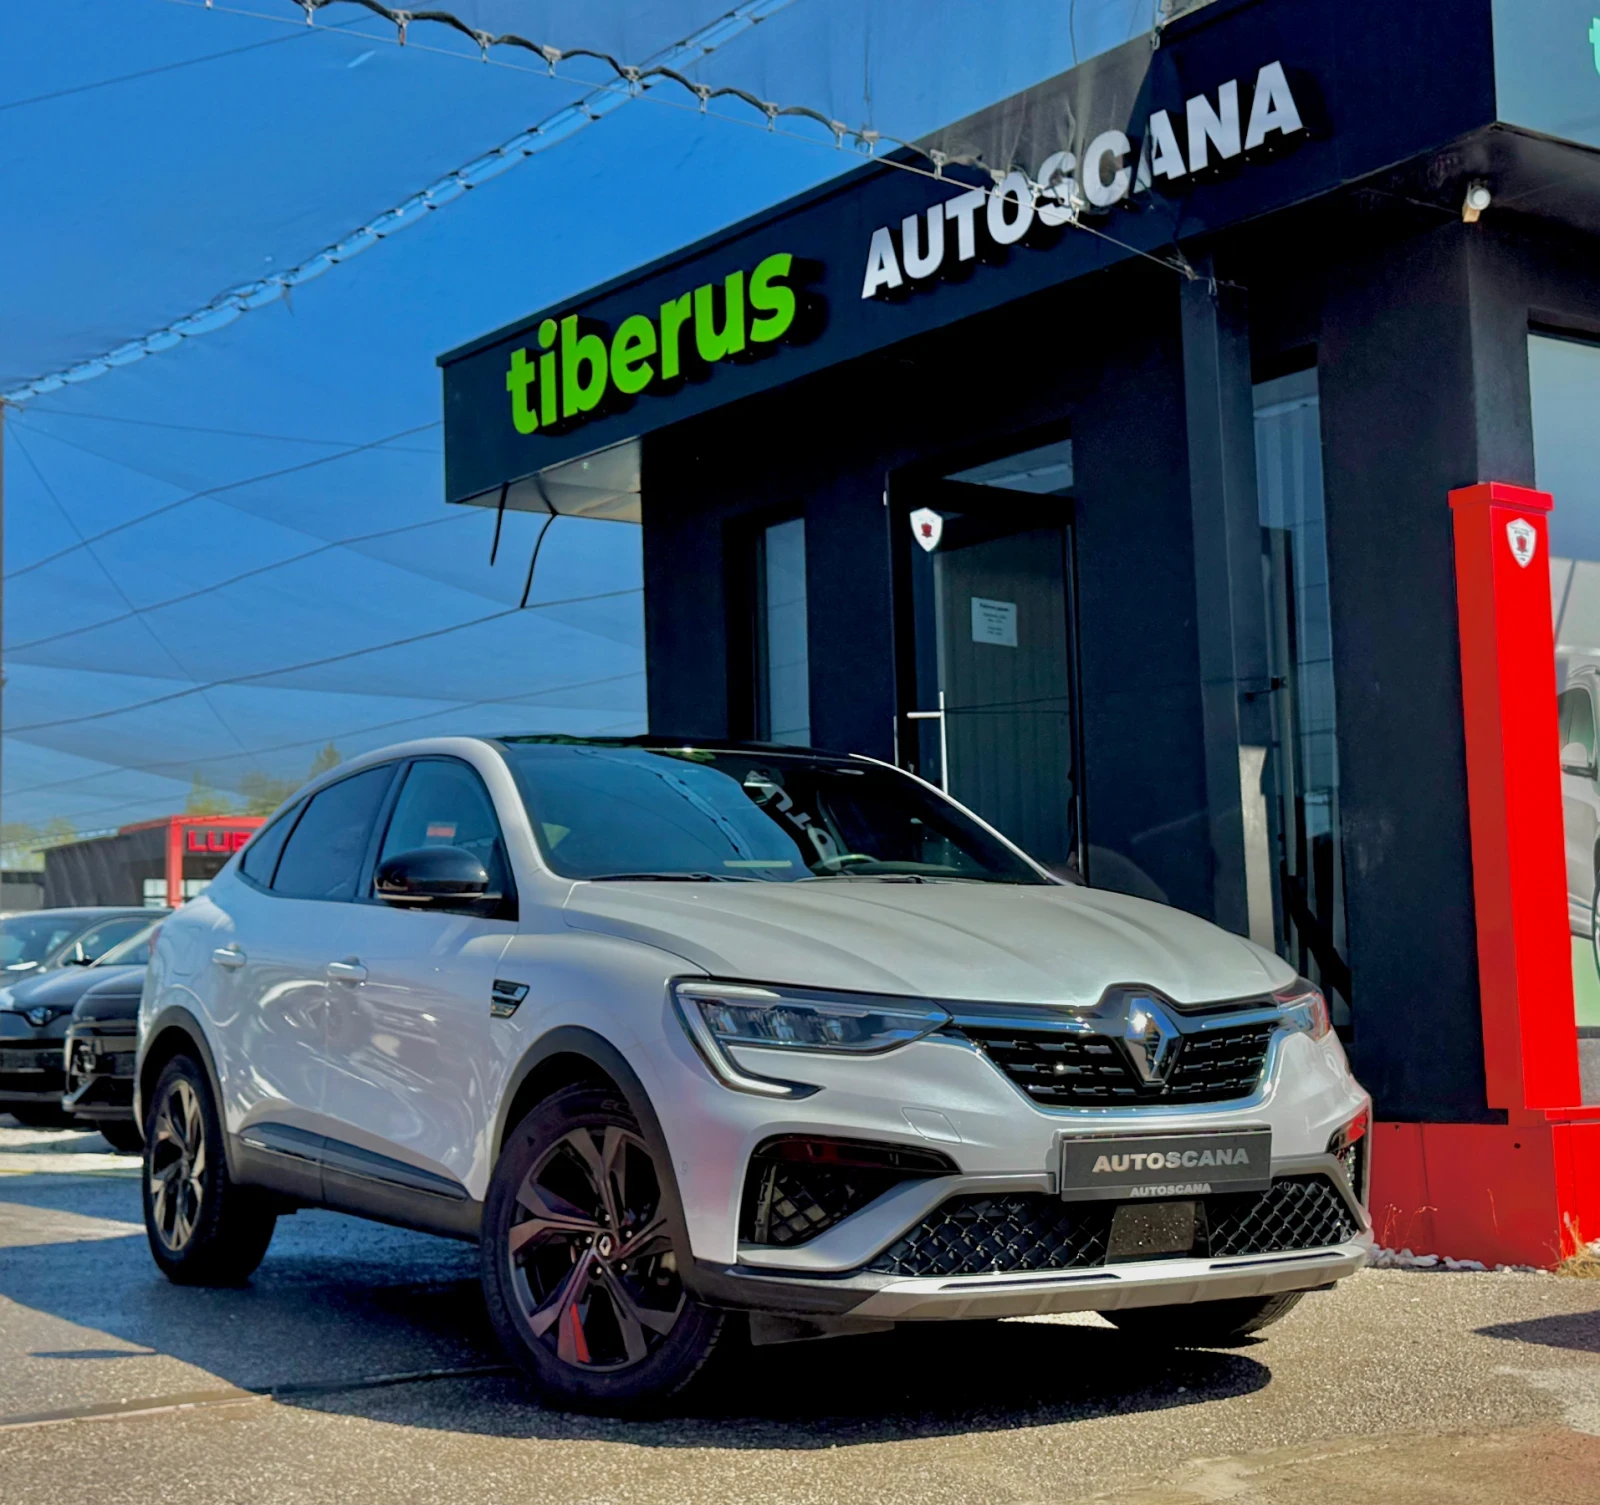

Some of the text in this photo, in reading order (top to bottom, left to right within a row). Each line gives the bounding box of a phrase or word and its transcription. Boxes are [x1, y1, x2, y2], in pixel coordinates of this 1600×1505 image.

[506, 60, 1304, 435] tiberus AUTOSCANA
[1092, 1147, 1250, 1174] AUTOSCANA
[1129, 1182, 1213, 1199] AUTOSCANA
